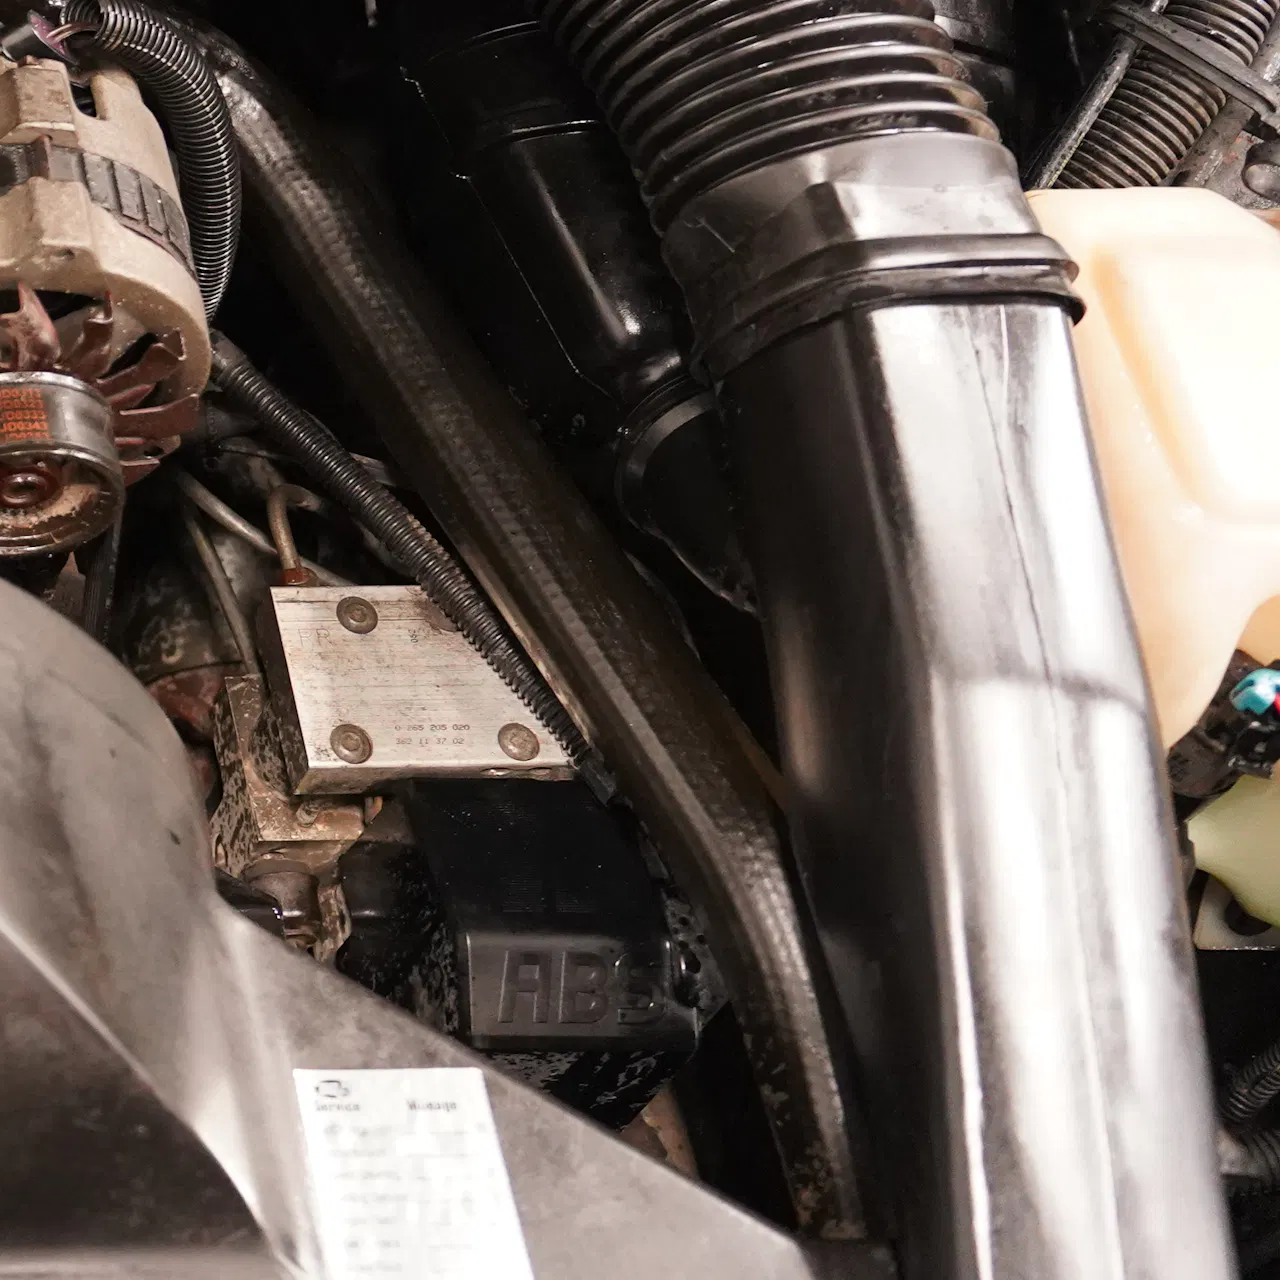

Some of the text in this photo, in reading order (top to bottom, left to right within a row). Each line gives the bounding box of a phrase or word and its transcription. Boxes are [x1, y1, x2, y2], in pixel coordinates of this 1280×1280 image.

[429, 723, 448, 732] 205
[451, 723, 471, 731] 020
[496, 949, 666, 1025] ABS
